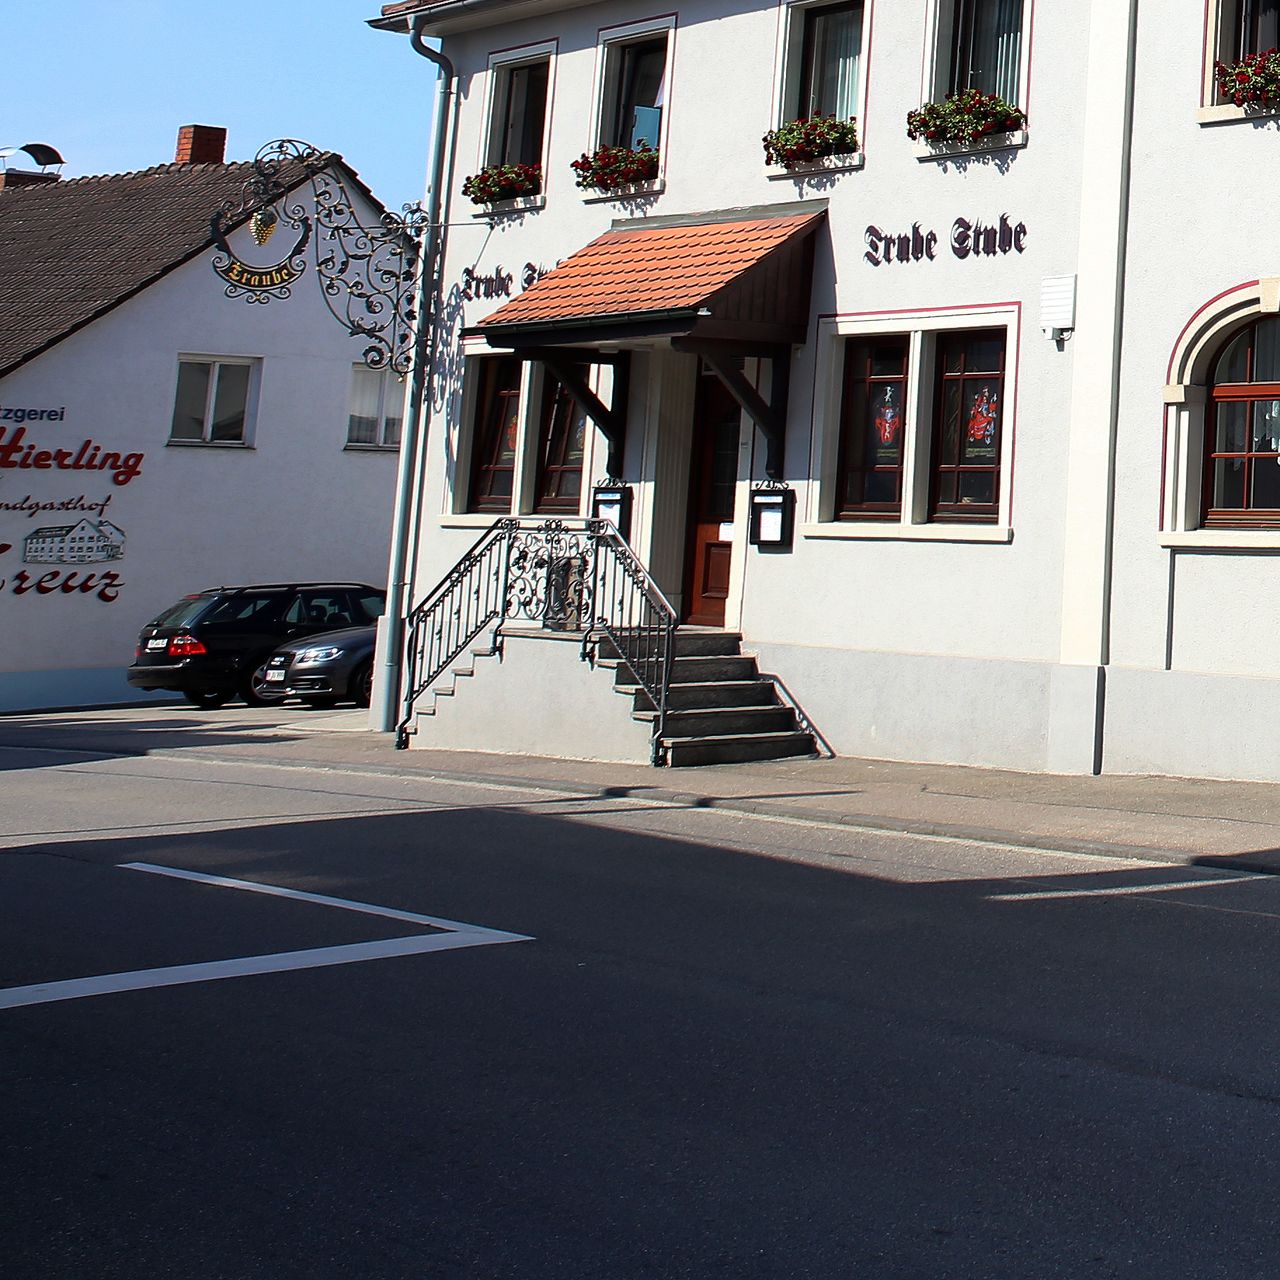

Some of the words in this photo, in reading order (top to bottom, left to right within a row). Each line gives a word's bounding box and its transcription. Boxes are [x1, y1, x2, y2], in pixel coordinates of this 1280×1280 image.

[863, 221, 938, 267] Trube
[951, 212, 1027, 259] Stube
[228, 262, 289, 286] Traube
